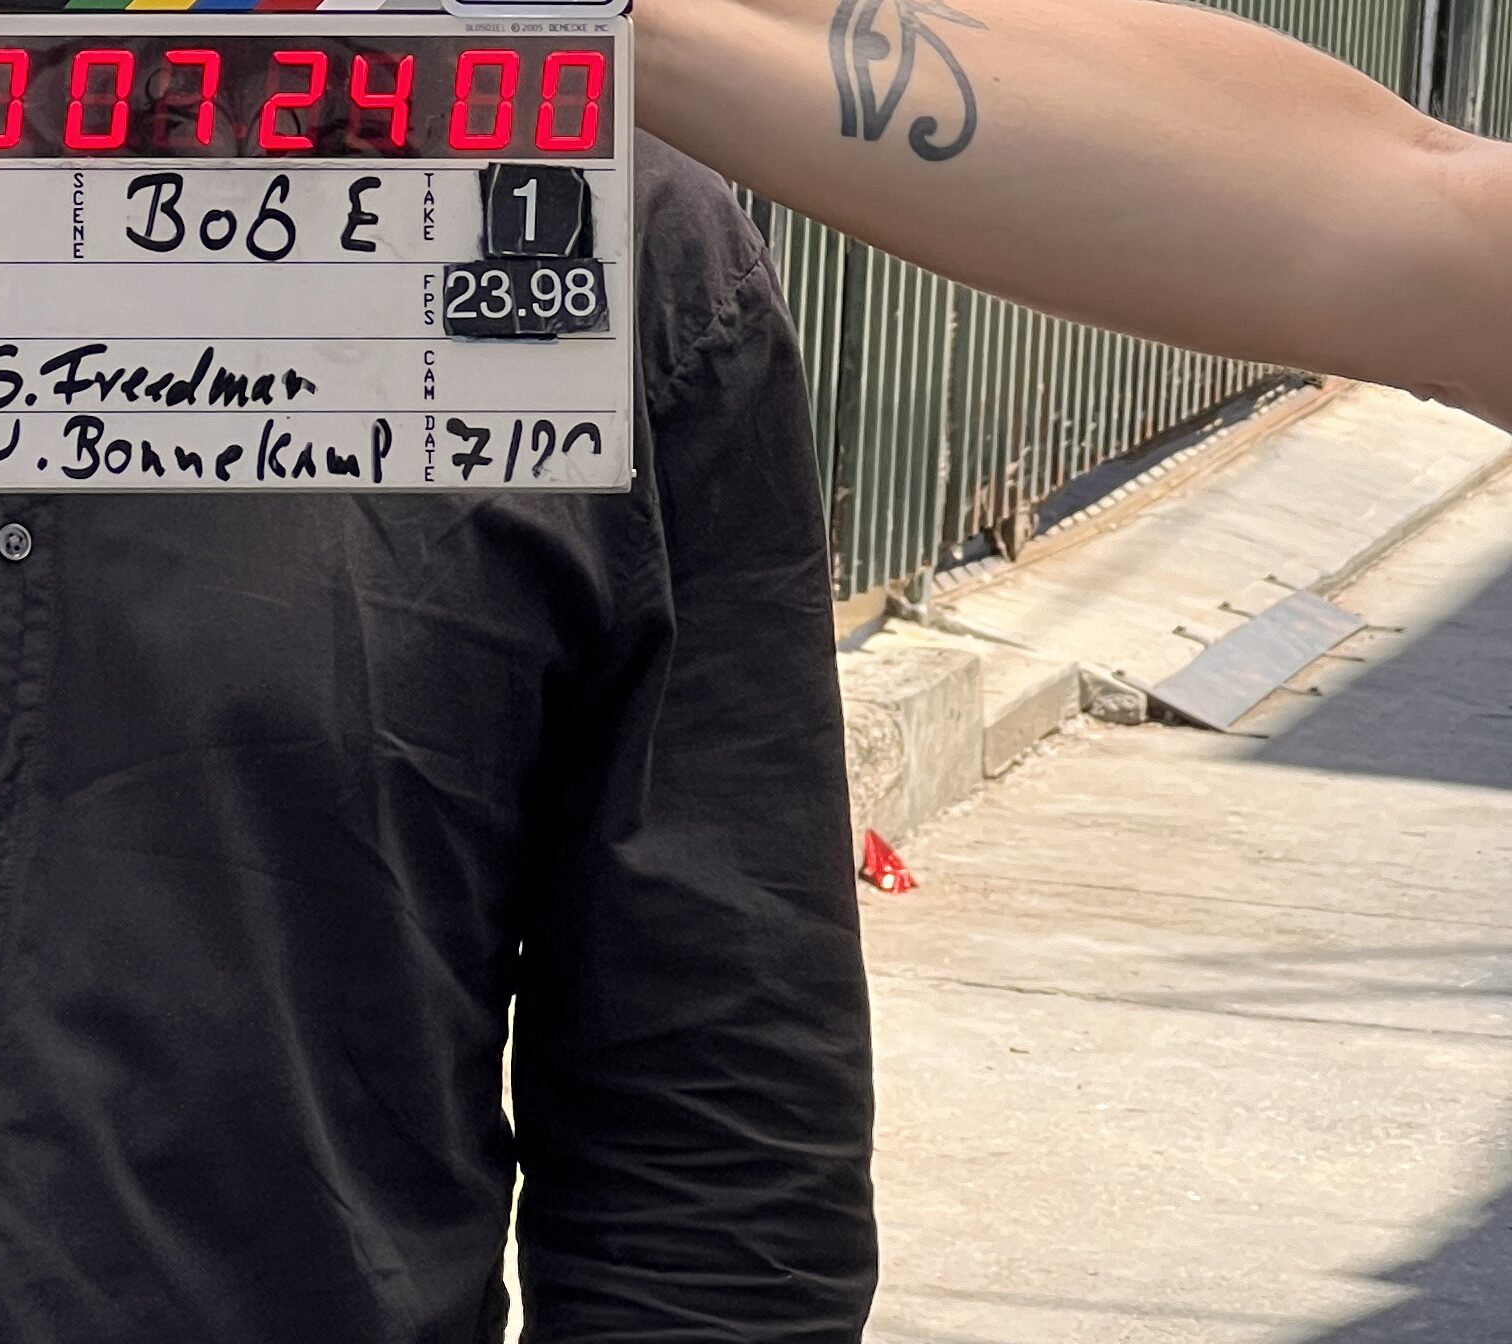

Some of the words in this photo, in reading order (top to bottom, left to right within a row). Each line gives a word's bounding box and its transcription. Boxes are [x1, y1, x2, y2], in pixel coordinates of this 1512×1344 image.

[73, 172, 84, 259] SCENE
[423, 173, 435, 241] TAKE
[513, 178, 538, 242] 1
[423, 275, 435, 326] FPS
[446, 268, 596, 319] 23.98
[424, 350, 435, 400] CAM
[424, 415, 435, 482] DATE
